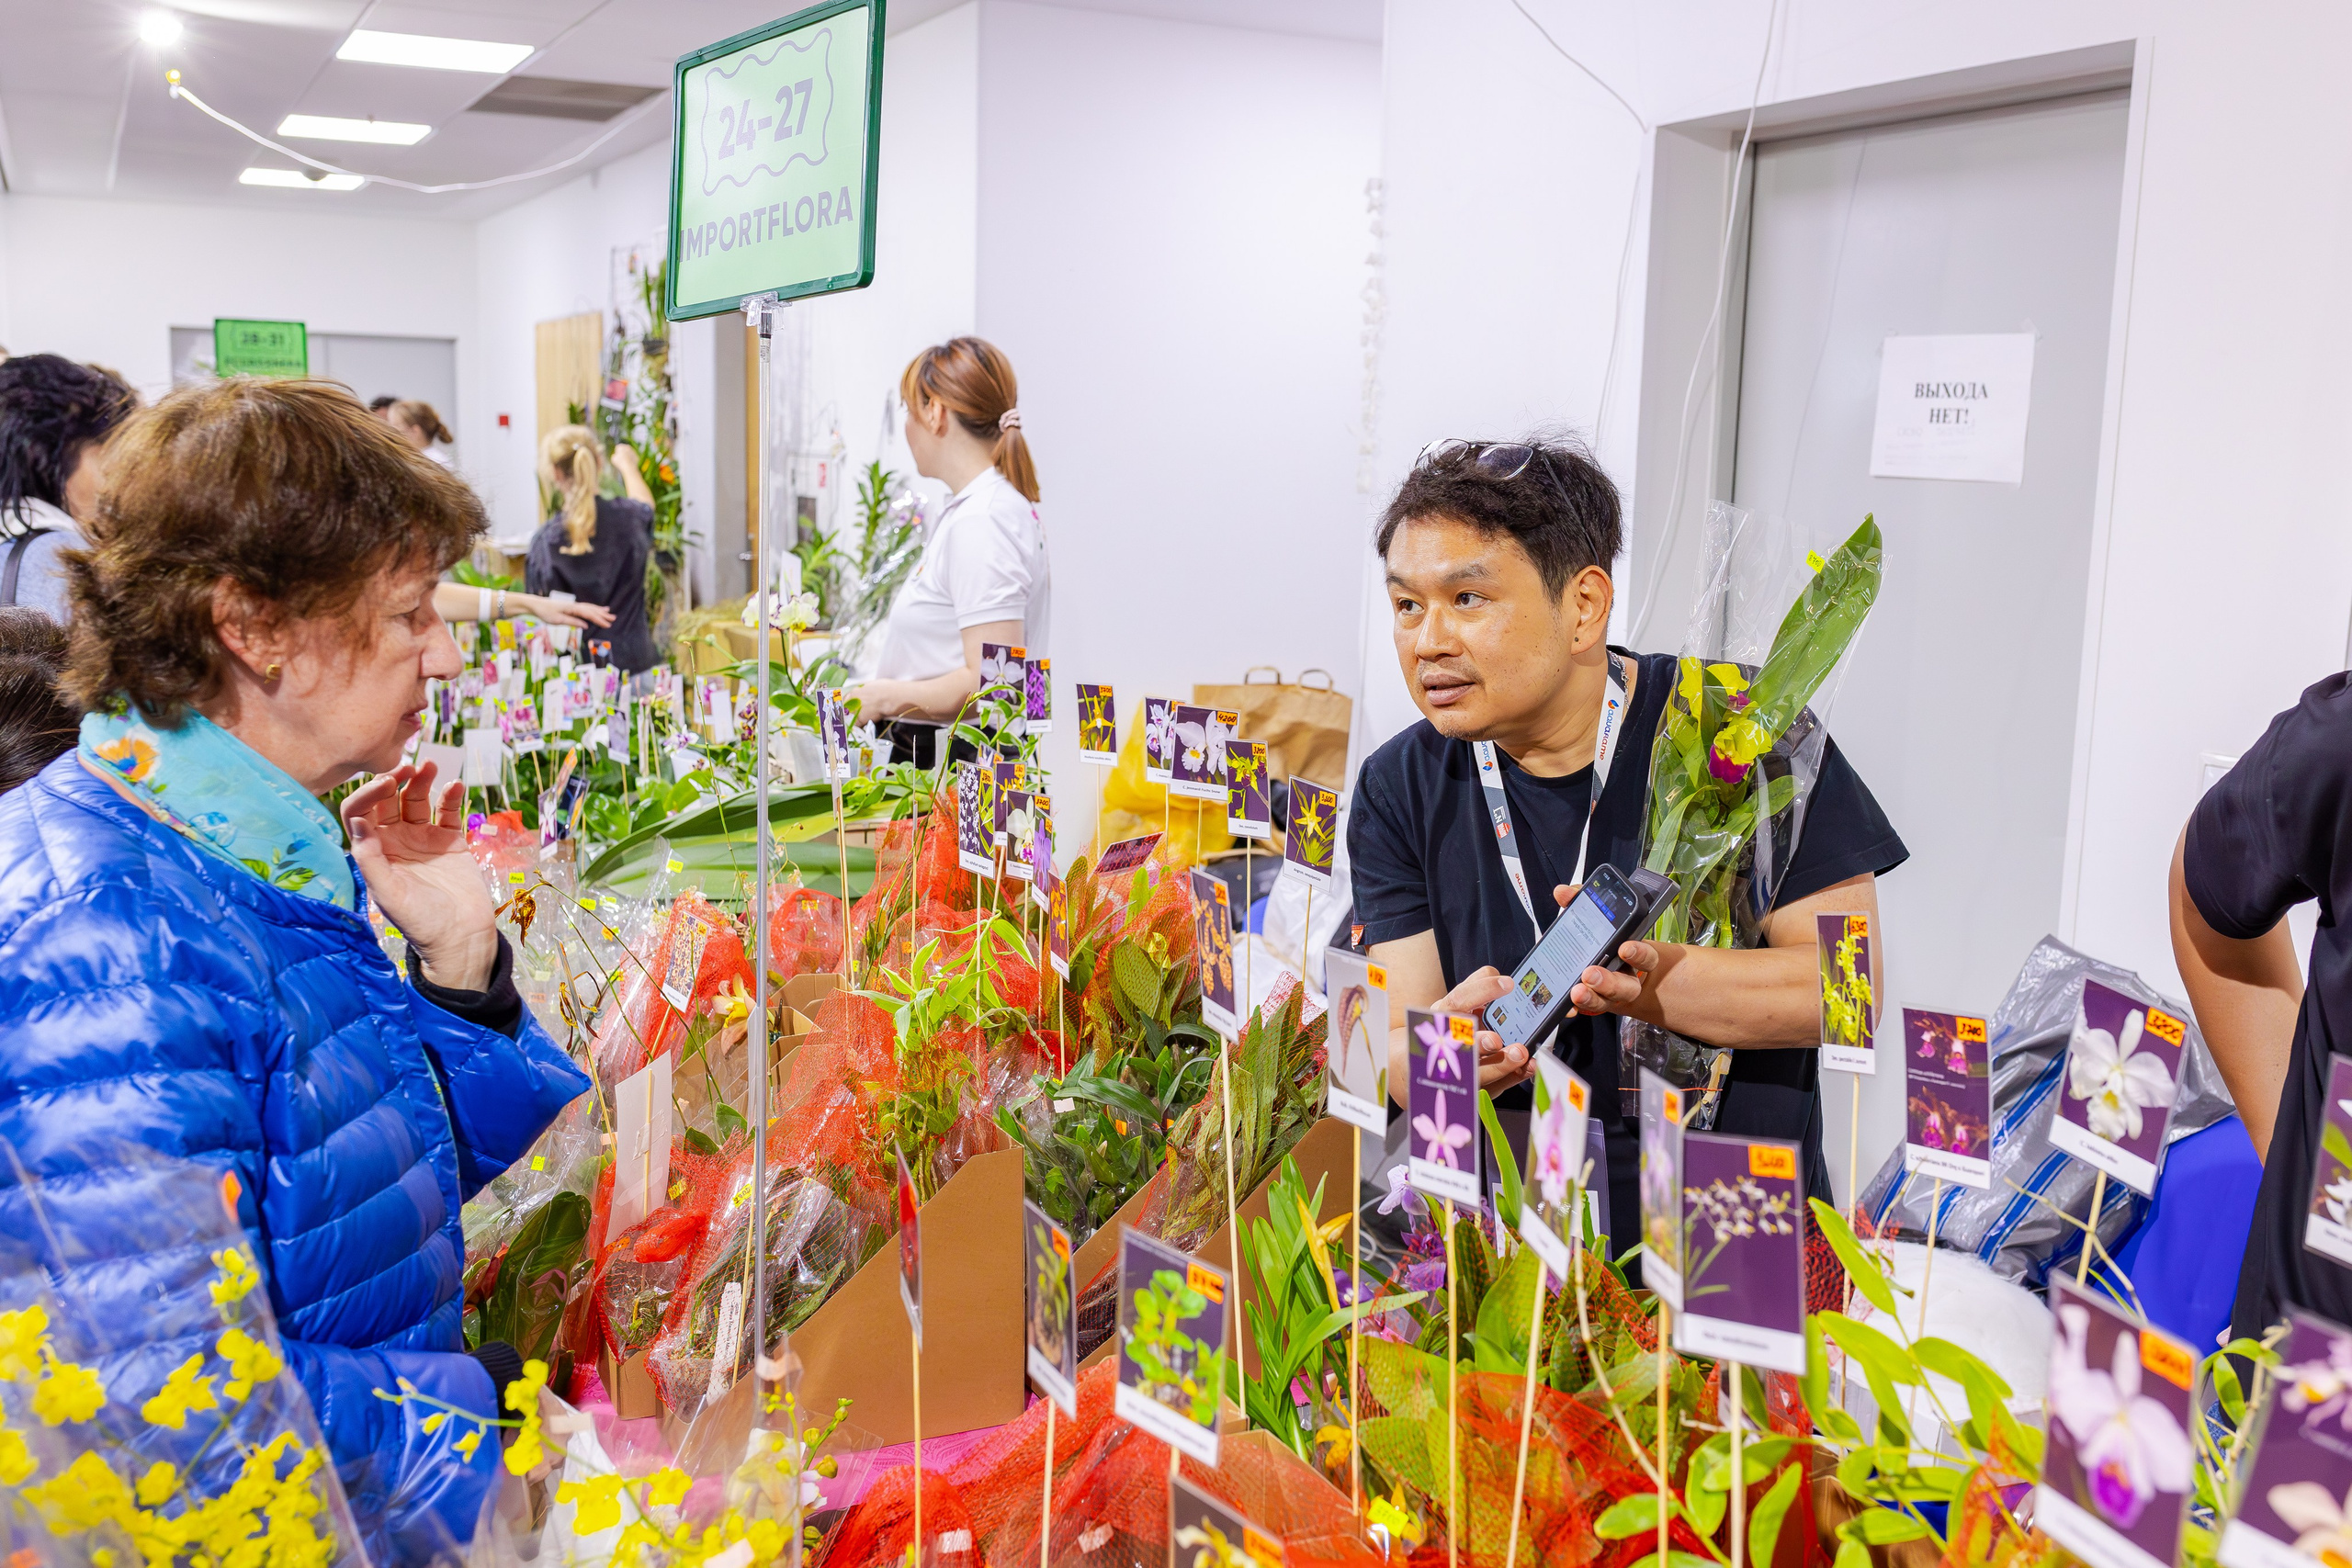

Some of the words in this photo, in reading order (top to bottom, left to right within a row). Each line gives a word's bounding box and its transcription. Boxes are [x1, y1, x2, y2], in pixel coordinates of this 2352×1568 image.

[718, 77, 813, 161] 24-27
[679, 186, 854, 263] IMPORTFLORA
[1914, 381, 1989, 400] ВЫХОДА
[1928, 407, 1970, 425] НЕТ!
[1217, 714, 1237, 723] 4200
